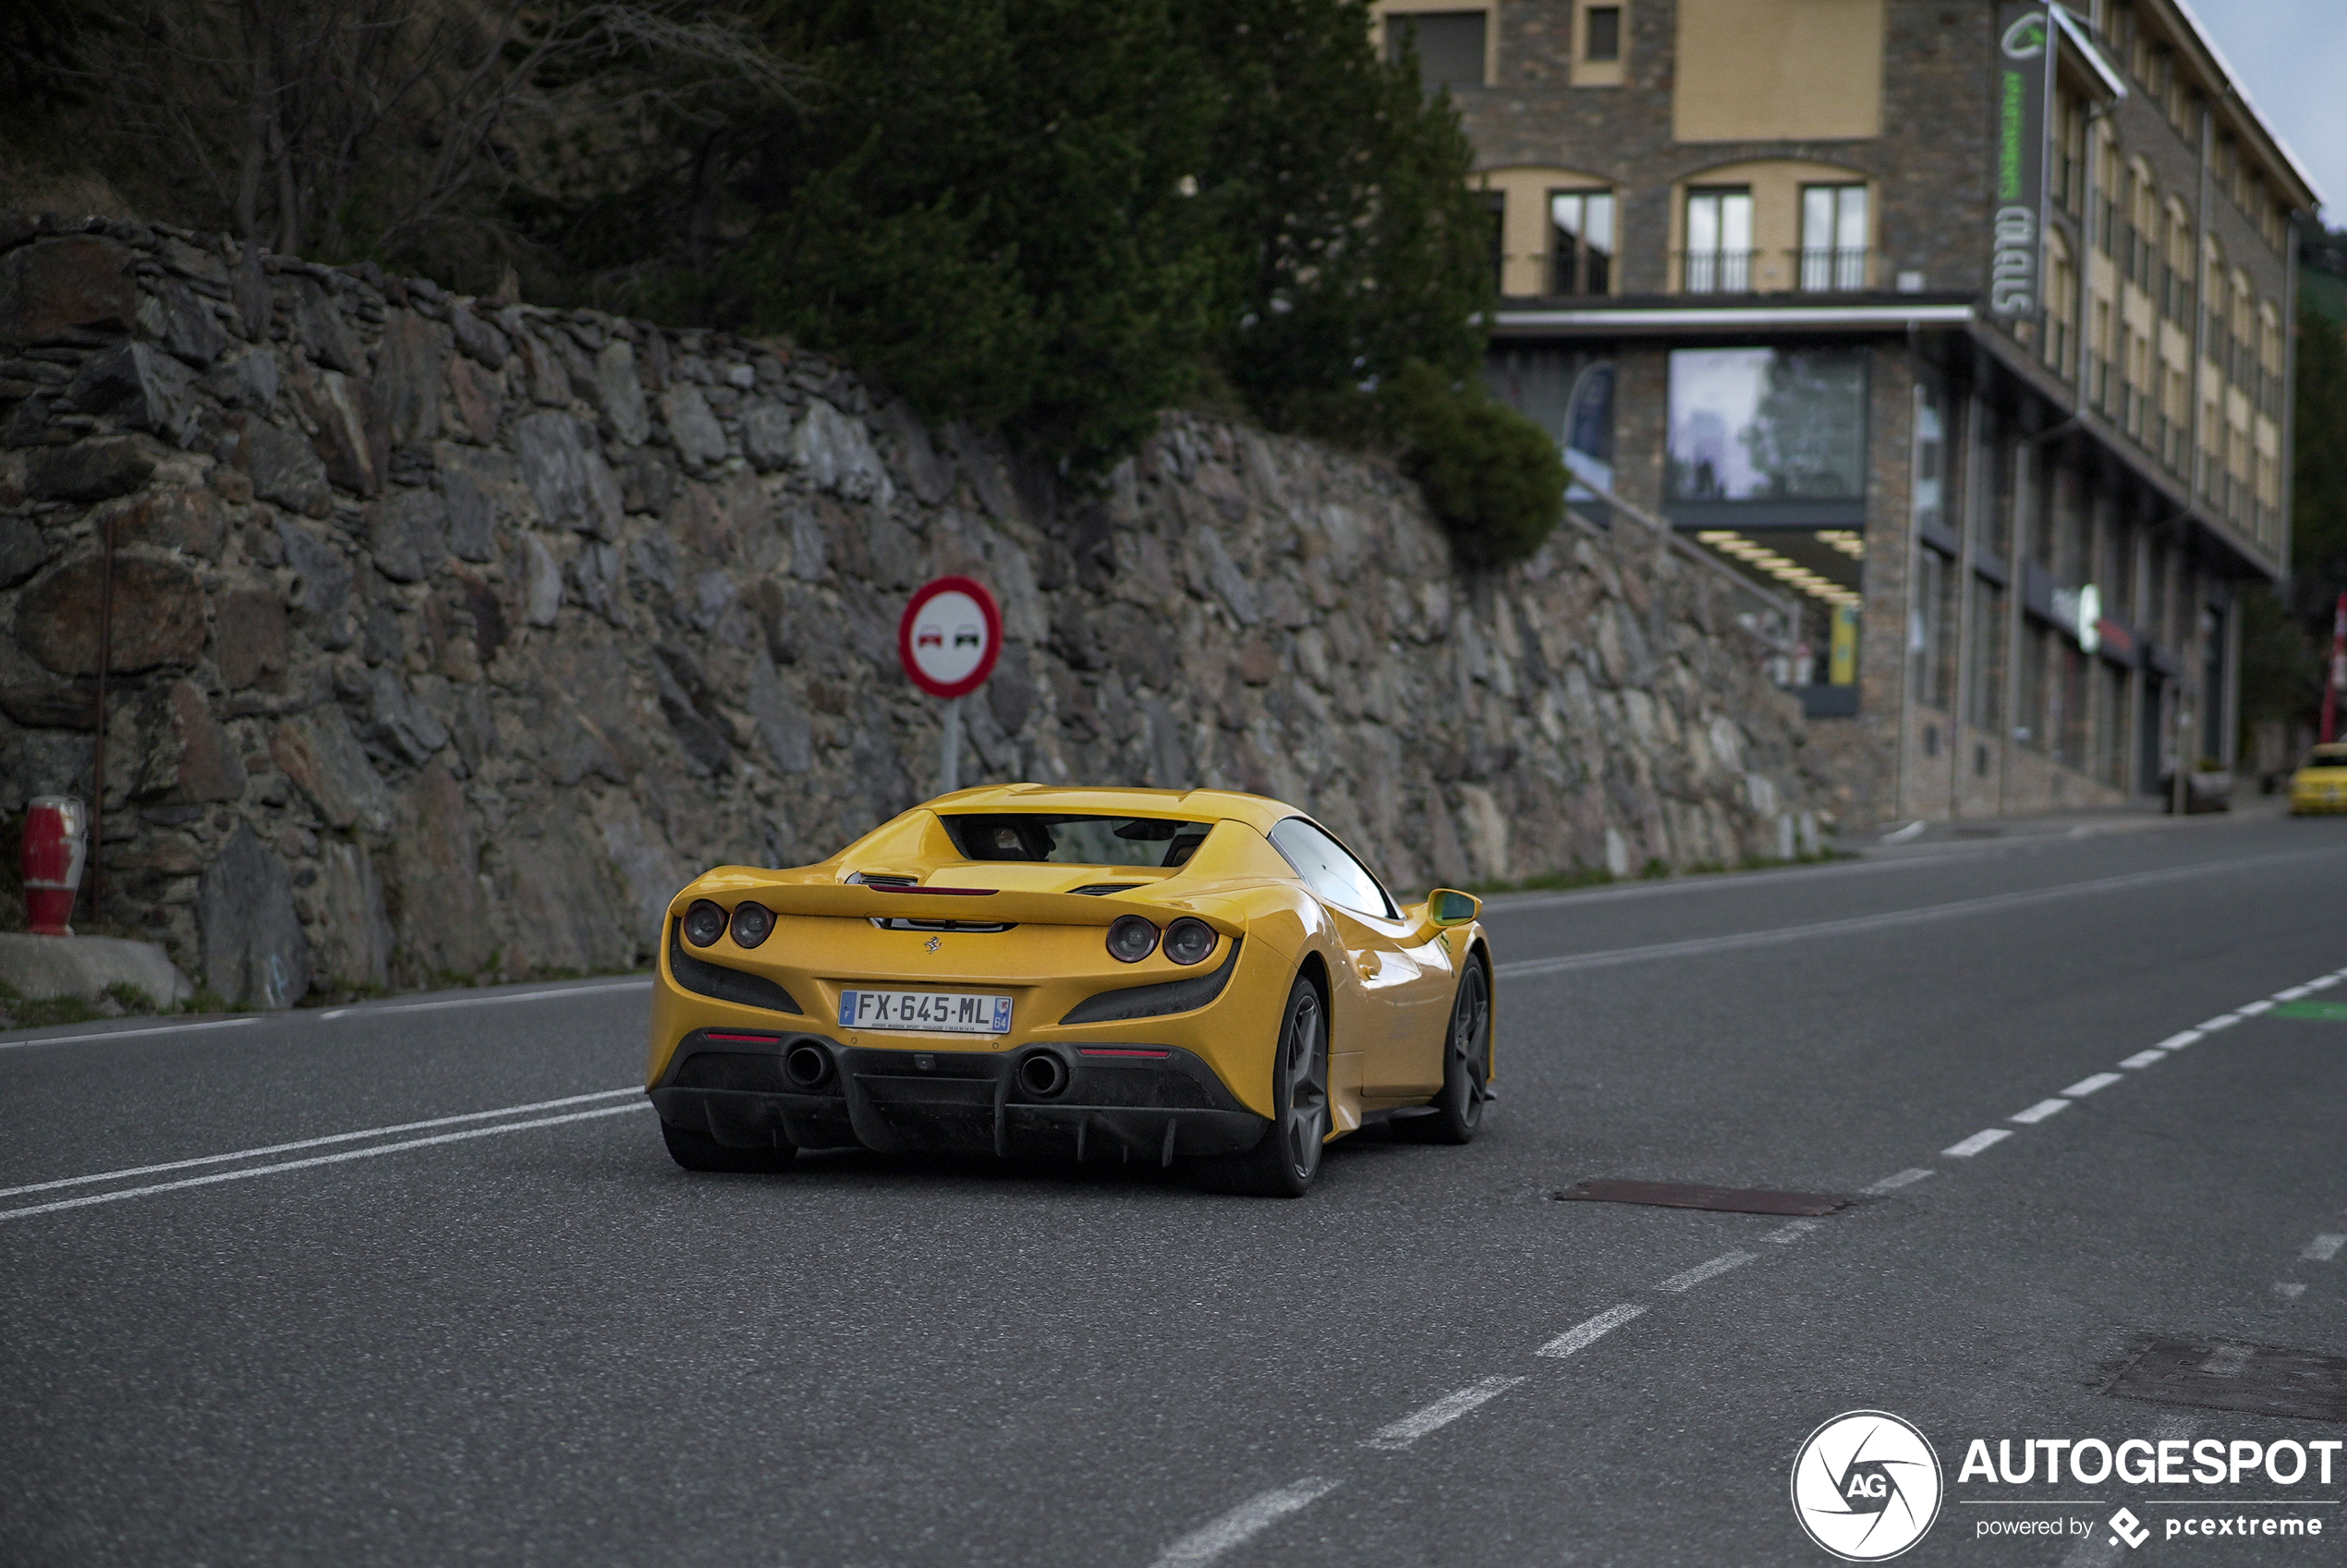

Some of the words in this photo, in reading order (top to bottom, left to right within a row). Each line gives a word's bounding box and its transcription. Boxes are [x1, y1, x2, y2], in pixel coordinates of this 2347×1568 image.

[845, 1011, 850, 1019] F
[858, 994, 989, 1024] FX-645-ML
[994, 1016, 1006, 1028] 64
